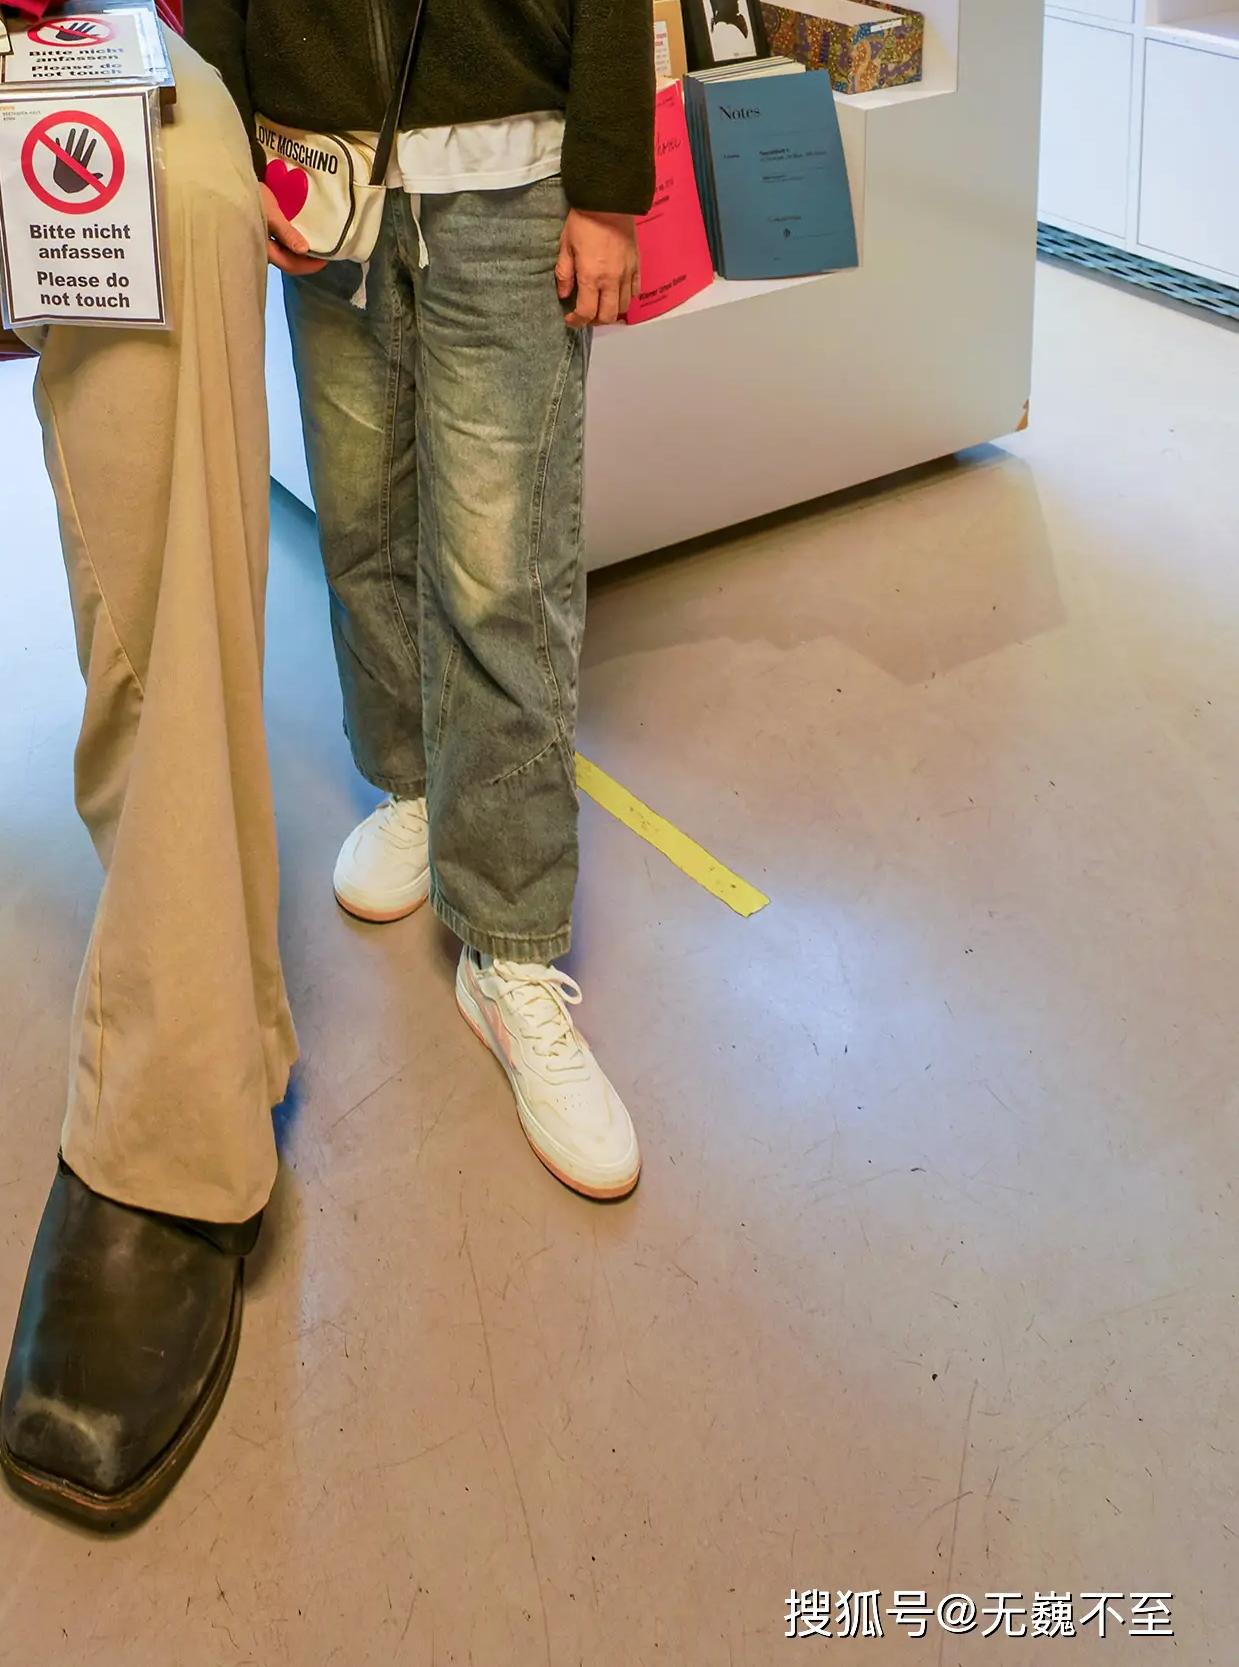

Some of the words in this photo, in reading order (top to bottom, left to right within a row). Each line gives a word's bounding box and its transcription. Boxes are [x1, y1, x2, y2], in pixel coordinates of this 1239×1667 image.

[36, 54, 119, 62] anfassen
[79, 47, 124, 55] nicht
[31, 64, 94, 72] Please
[32, 70, 63, 78] not
[719, 106, 761, 122] Notes
[257, 126, 276, 150] OVE
[276, 135, 338, 174] MOSCHINO
[29, 224, 76, 240] Bitte
[82, 224, 131, 240] nicht
[38, 244, 125, 259] anfassen
[36, 271, 100, 287] Please
[106, 272, 130, 288] do
[40, 292, 70, 306] not
[76, 292, 130, 308] touch
